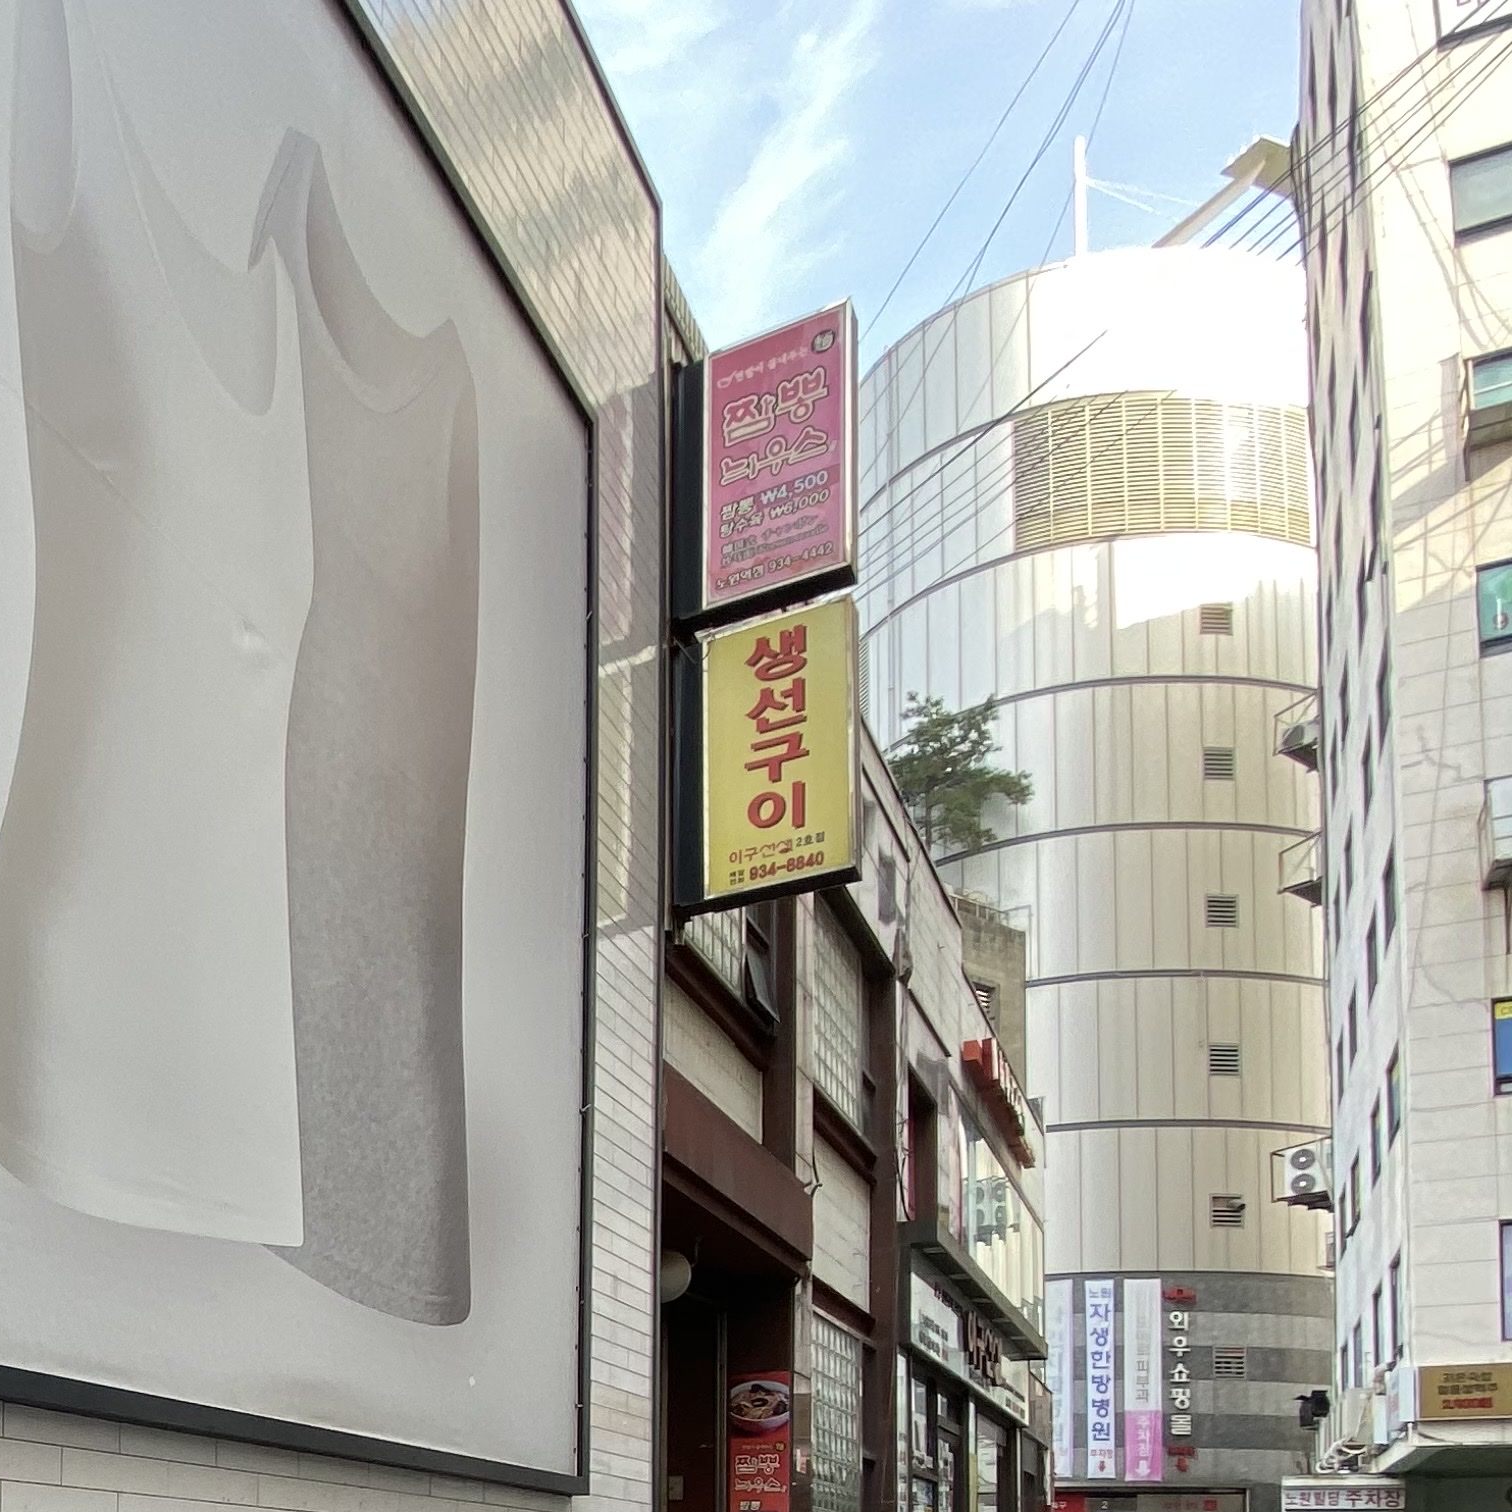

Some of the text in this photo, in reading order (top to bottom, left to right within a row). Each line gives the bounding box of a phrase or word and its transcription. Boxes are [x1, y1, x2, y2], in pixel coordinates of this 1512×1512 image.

[768, 540, 834, 573] 934-4442
[744, 624, 810, 829] 생선구이
[1089, 1303, 1112, 1442] 자생한방병원
[1101, 1500, 1109, 1510] 2
[1346, 1487, 1401, 1508] 주차장
